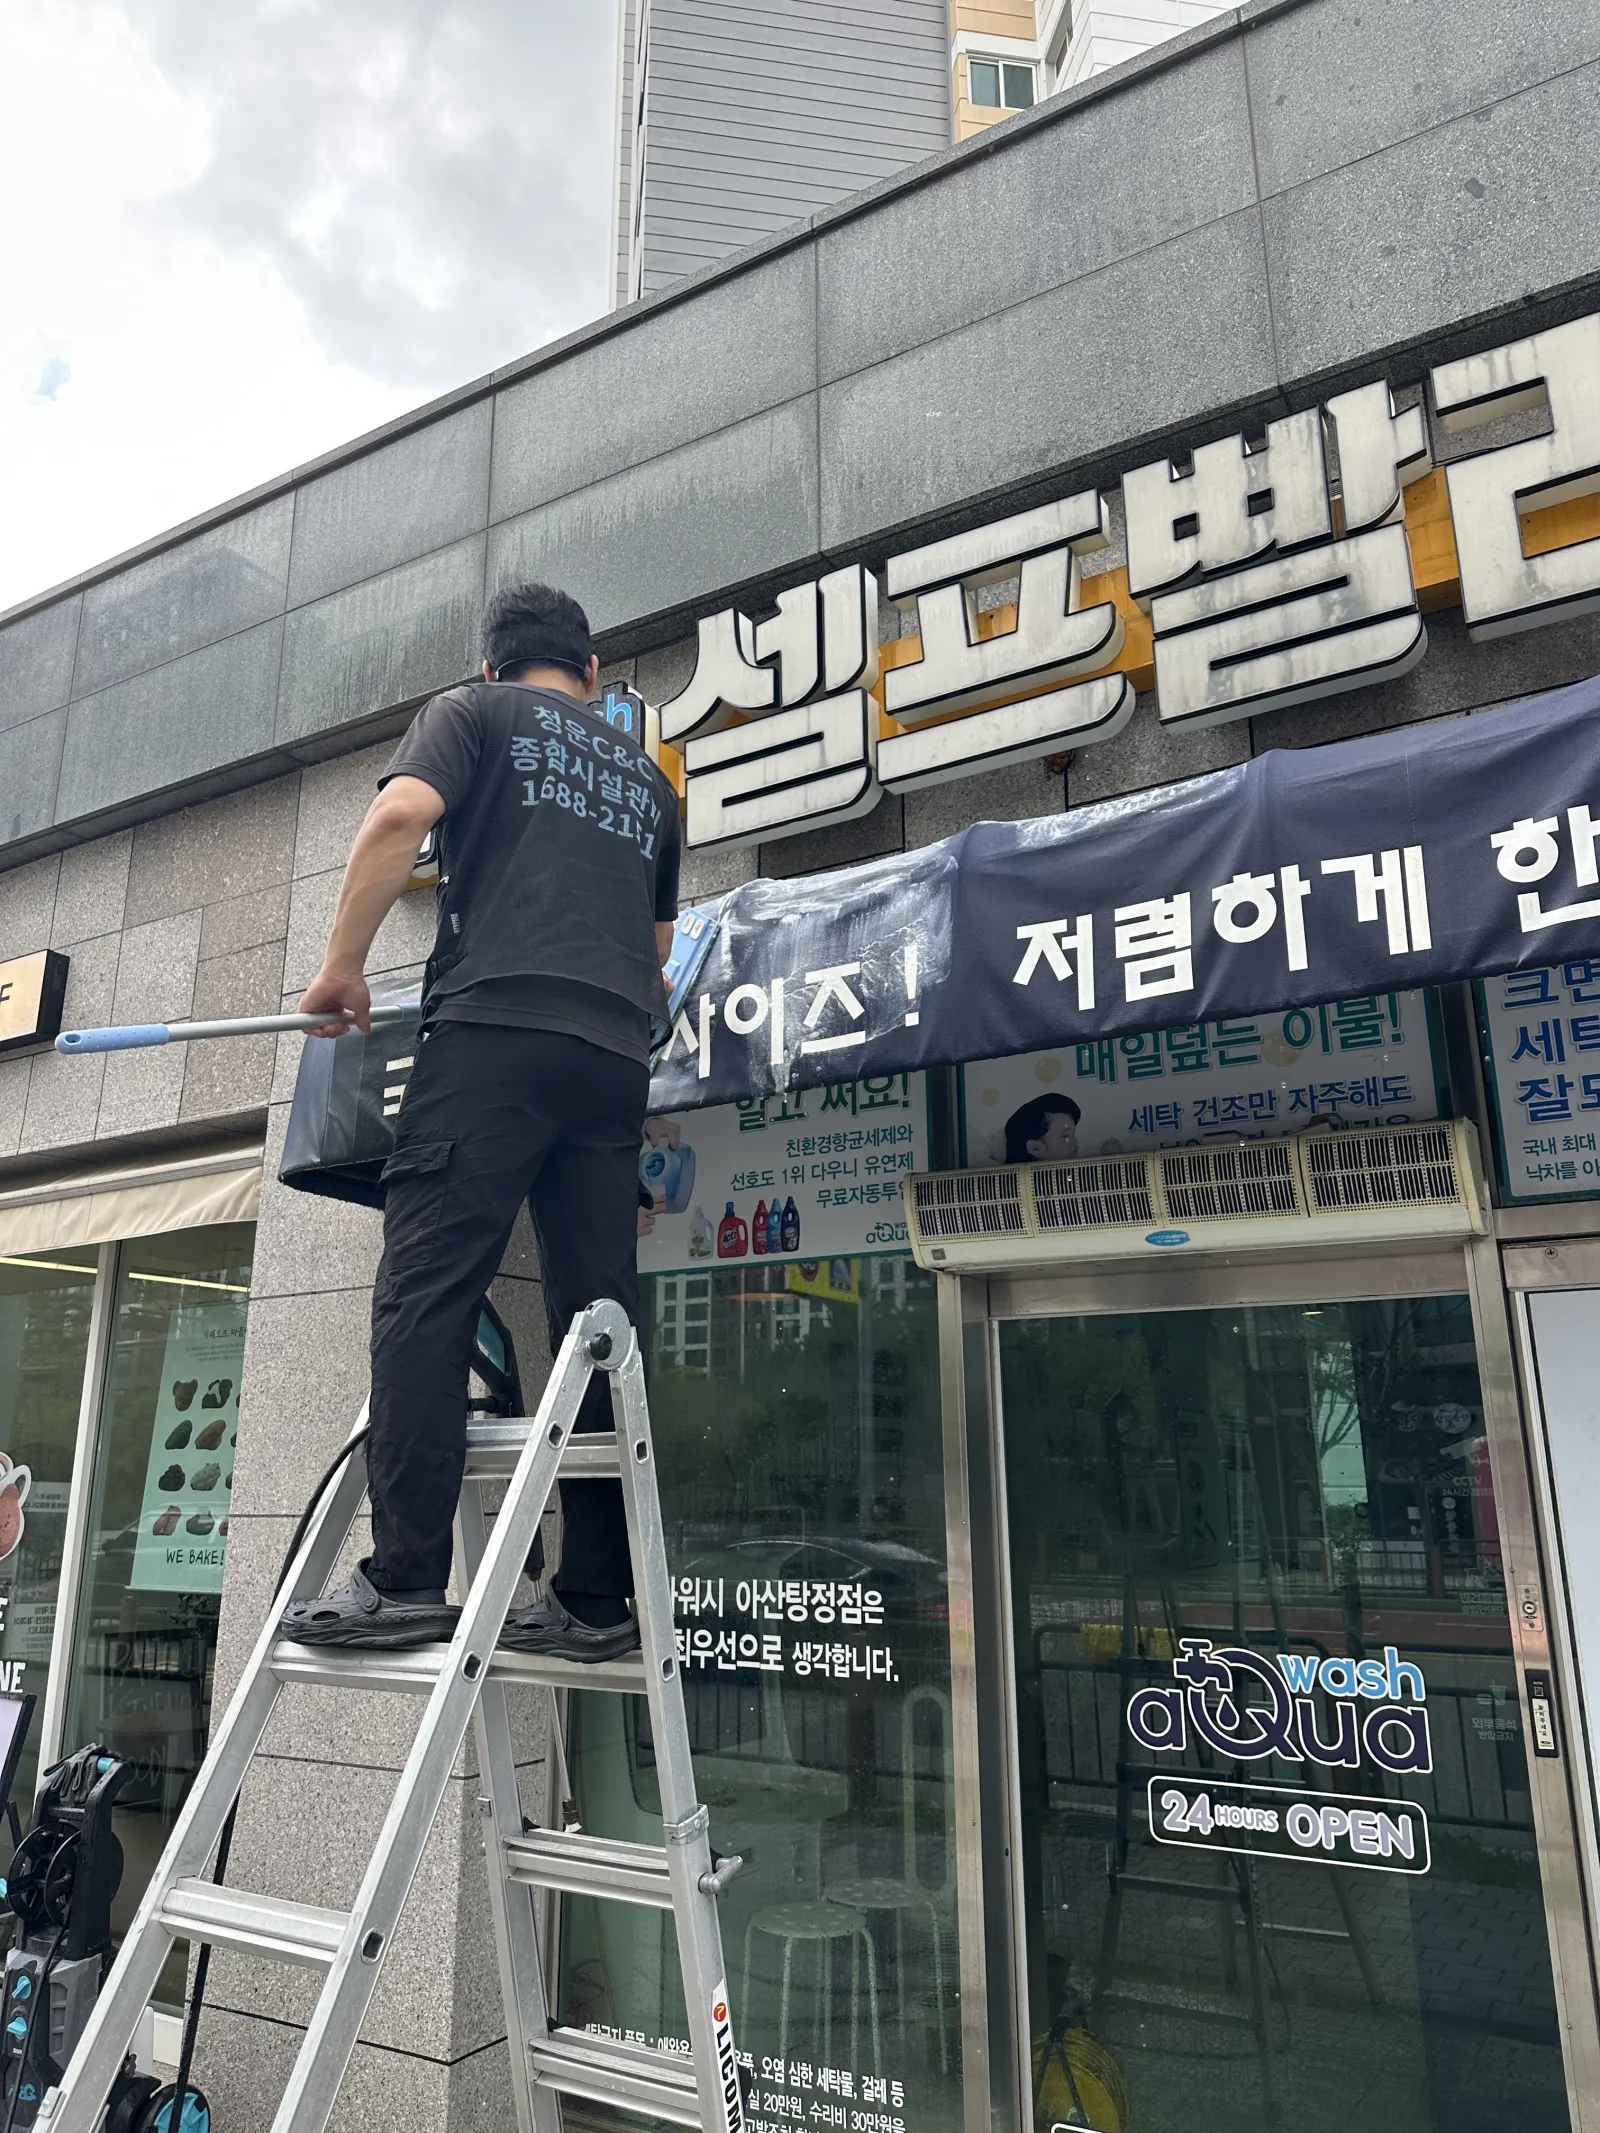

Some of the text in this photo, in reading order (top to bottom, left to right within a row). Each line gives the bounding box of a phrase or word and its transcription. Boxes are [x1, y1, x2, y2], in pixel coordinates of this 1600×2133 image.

[533, 705, 653, 782] 청운C&C
[1012, 845, 1432, 1012] 저렴하게
[1490, 804, 1600, 933] 한
[1075, 992, 1405, 1082] 매일덮는 이불!
[1128, 1101, 1182, 1134] 세탁
[1193, 1088, 1277, 1128] 건조만
[1287, 1074, 1415, 1116] 자주해도
[786, 1123, 914, 1158] 친환경향균세제와
[1522, 1132, 1597, 1157] 국내 최대
[731, 1150, 914, 1192] 선호도 1위 다우니 유연제
[1525, 1160, 1578, 1182] 낙차를
[1453, 1475, 1483, 1487] CCTV
[166, 1548, 225, 1566] WE BAKE!
[735, 1578, 885, 1625] 아산탕정점은
[674, 1627, 900, 1682] 최우선으로 생각합니다.
[1277, 1646, 1426, 1701] wash
[1471, 1716, 1518, 1731] 외부음식
[1161, 1790, 1415, 1859] 24 HOURS OPEN
[761, 2056, 785, 2084] 오염
[788, 2060, 813, 2089] 심한
[816, 2066, 858, 2100] 세탁물,
[861, 2075, 887, 2105] 걸레
[890, 2080, 905, 2108] 등
[745, 2088, 760, 2111] 실
[763, 2092, 806, 2122] 20만원,
[809, 2100, 847, 2129] 수리비
